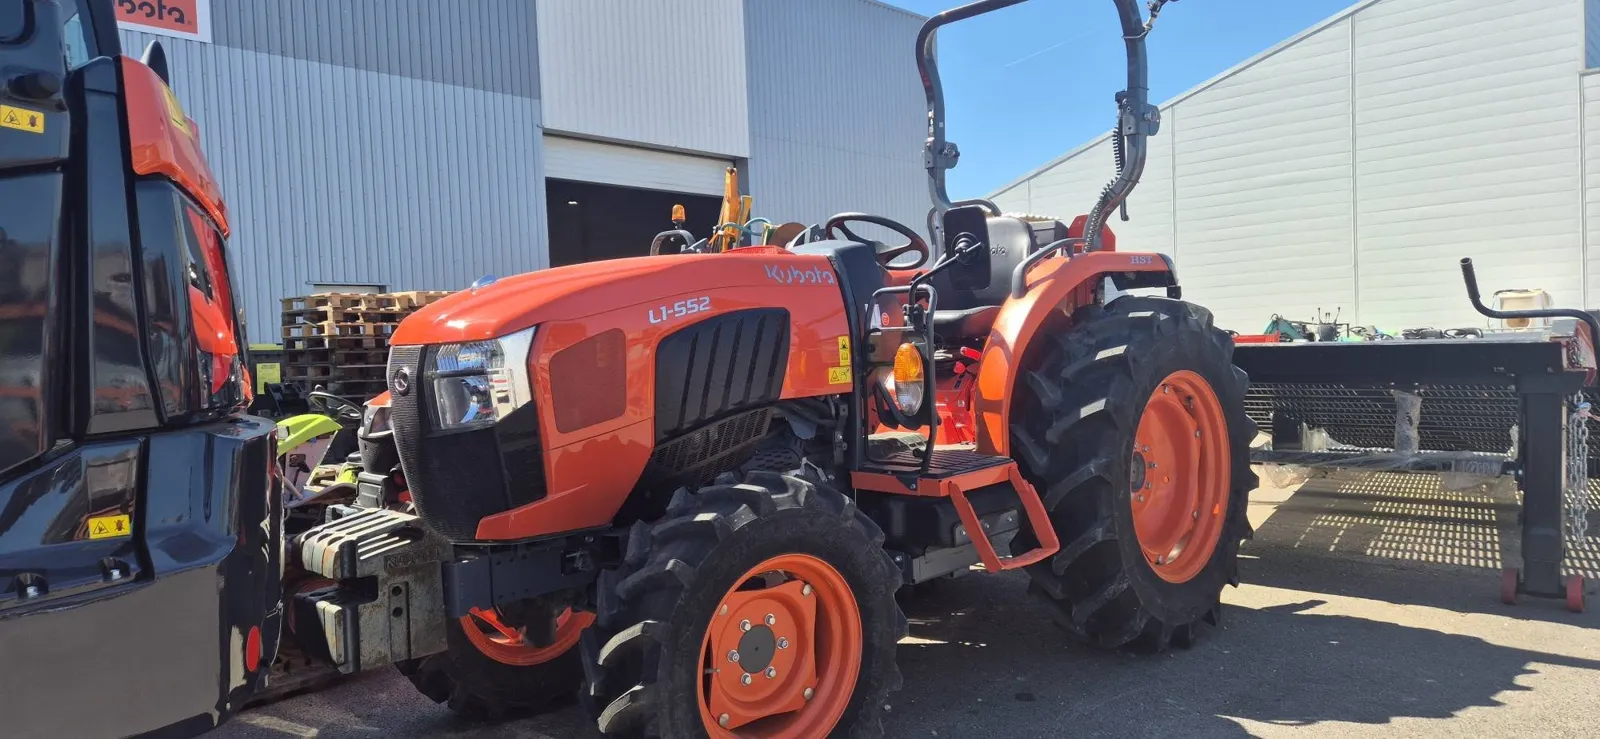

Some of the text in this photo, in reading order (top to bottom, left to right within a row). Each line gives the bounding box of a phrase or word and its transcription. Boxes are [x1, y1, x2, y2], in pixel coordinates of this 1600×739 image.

[117, 0, 185, 24] bota
[1130, 255, 1153, 265] HST
[764, 264, 835, 285] Kubota
